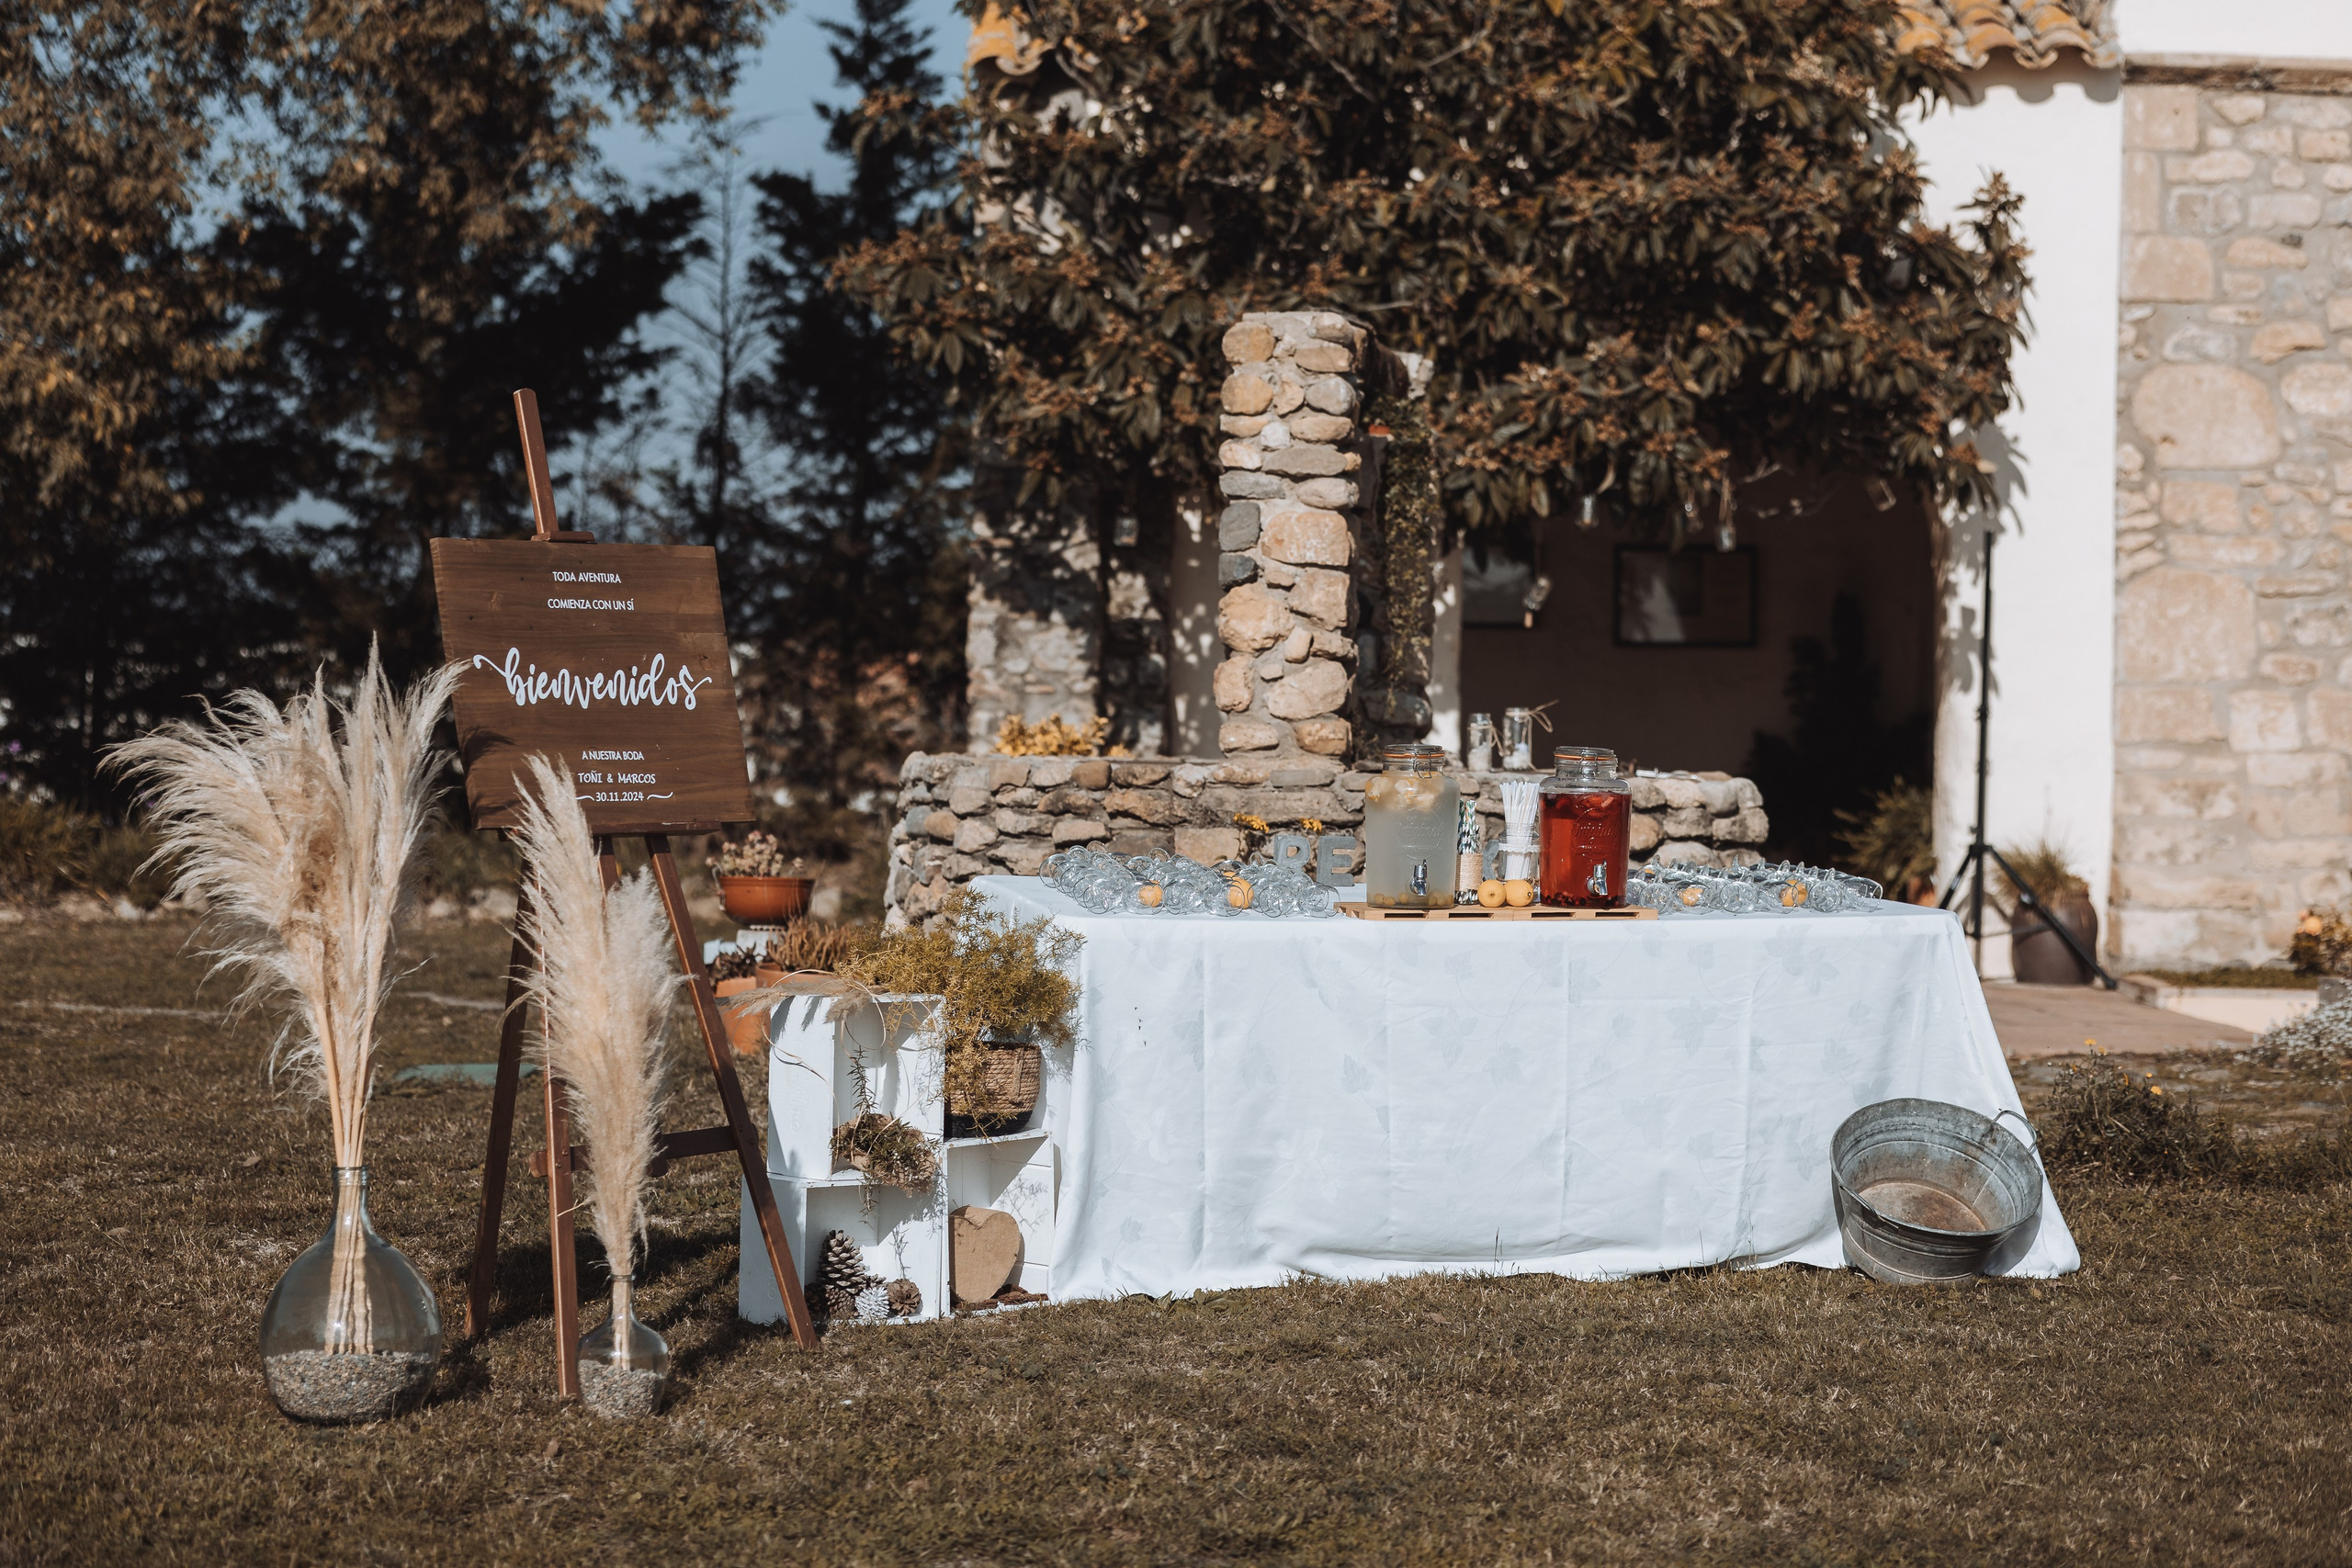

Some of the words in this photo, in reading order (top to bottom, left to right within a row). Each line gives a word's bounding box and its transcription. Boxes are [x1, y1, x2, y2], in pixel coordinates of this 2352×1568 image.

[552, 571, 577, 582] TODA
[578, 572, 622, 583] AVENTURA
[547, 598, 592, 610] COMIENZA
[592, 599, 612, 610] CON
[612, 600, 626, 611] UN
[627, 598, 635, 611] SÍ
[472, 647, 713, 711] bienvenidos
[582, 750, 589, 761] A
[589, 750, 622, 761] NUESTRA
[622, 750, 645, 761] BODA
[578, 770, 603, 784] TOÑI
[606, 773, 614, 784] &
[617, 773, 656, 784] MARCOS
[595, 791, 645, 802] 30.11.2024
